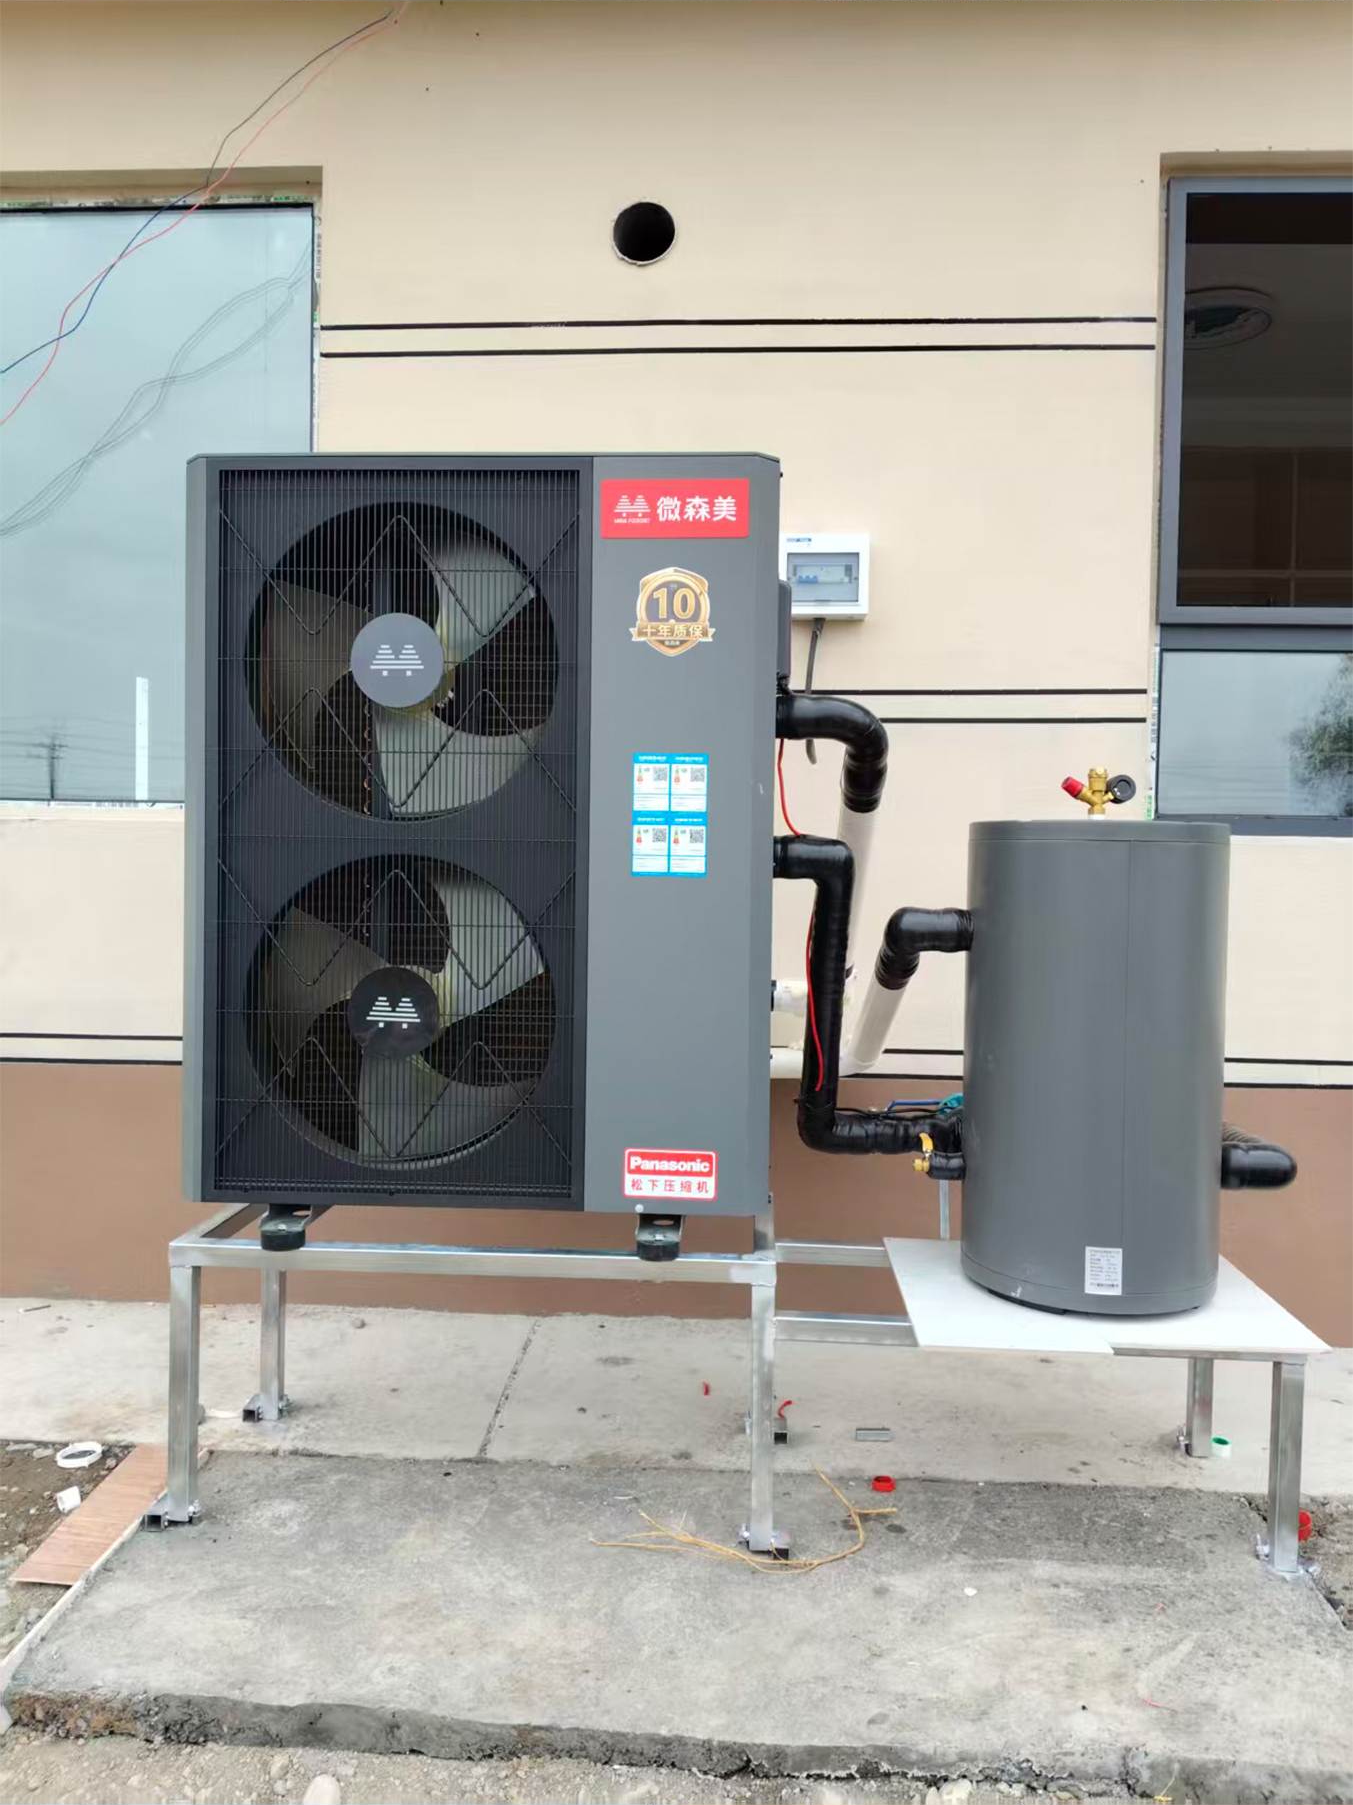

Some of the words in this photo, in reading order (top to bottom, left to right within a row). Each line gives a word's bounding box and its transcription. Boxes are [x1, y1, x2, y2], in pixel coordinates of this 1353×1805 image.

[657, 496, 737, 522] 微森美
[653, 588, 696, 619] 10
[642, 624, 703, 638] 十年质保
[629, 1156, 710, 1172] Panasonic
[630, 1178, 709, 1193] 松下压缩机
